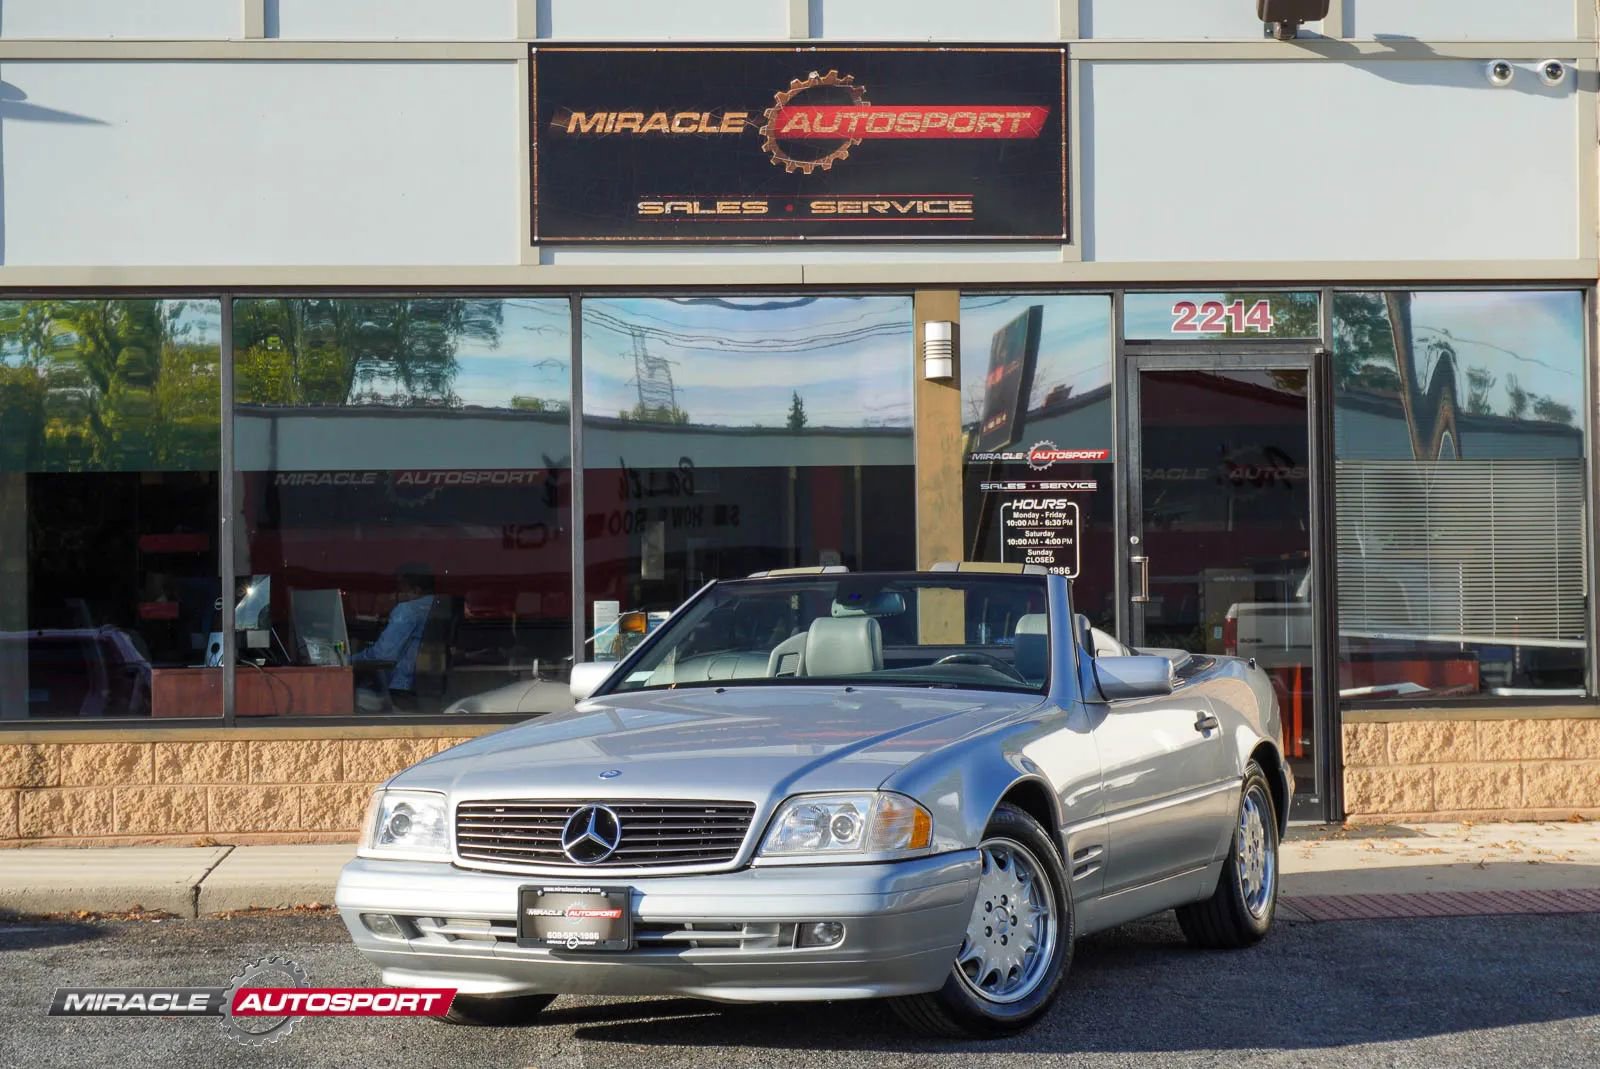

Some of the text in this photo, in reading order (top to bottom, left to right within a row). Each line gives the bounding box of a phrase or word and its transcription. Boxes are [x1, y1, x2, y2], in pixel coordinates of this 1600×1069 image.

[566, 111, 1032, 134] MIRACLE AUTOSPORT
[637, 200, 973, 214] SALES SERVICE
[1172, 299, 1273, 333] 2214
[972, 451, 1105, 460] MIRACLE AUTOSPORT
[274, 470, 539, 485] MIRACLE AUTOSPORT
[1012, 499, 1068, 510] HOURS
[1027, 549, 1053, 557] Sunday
[1025, 556, 1055, 564] CLOSED
